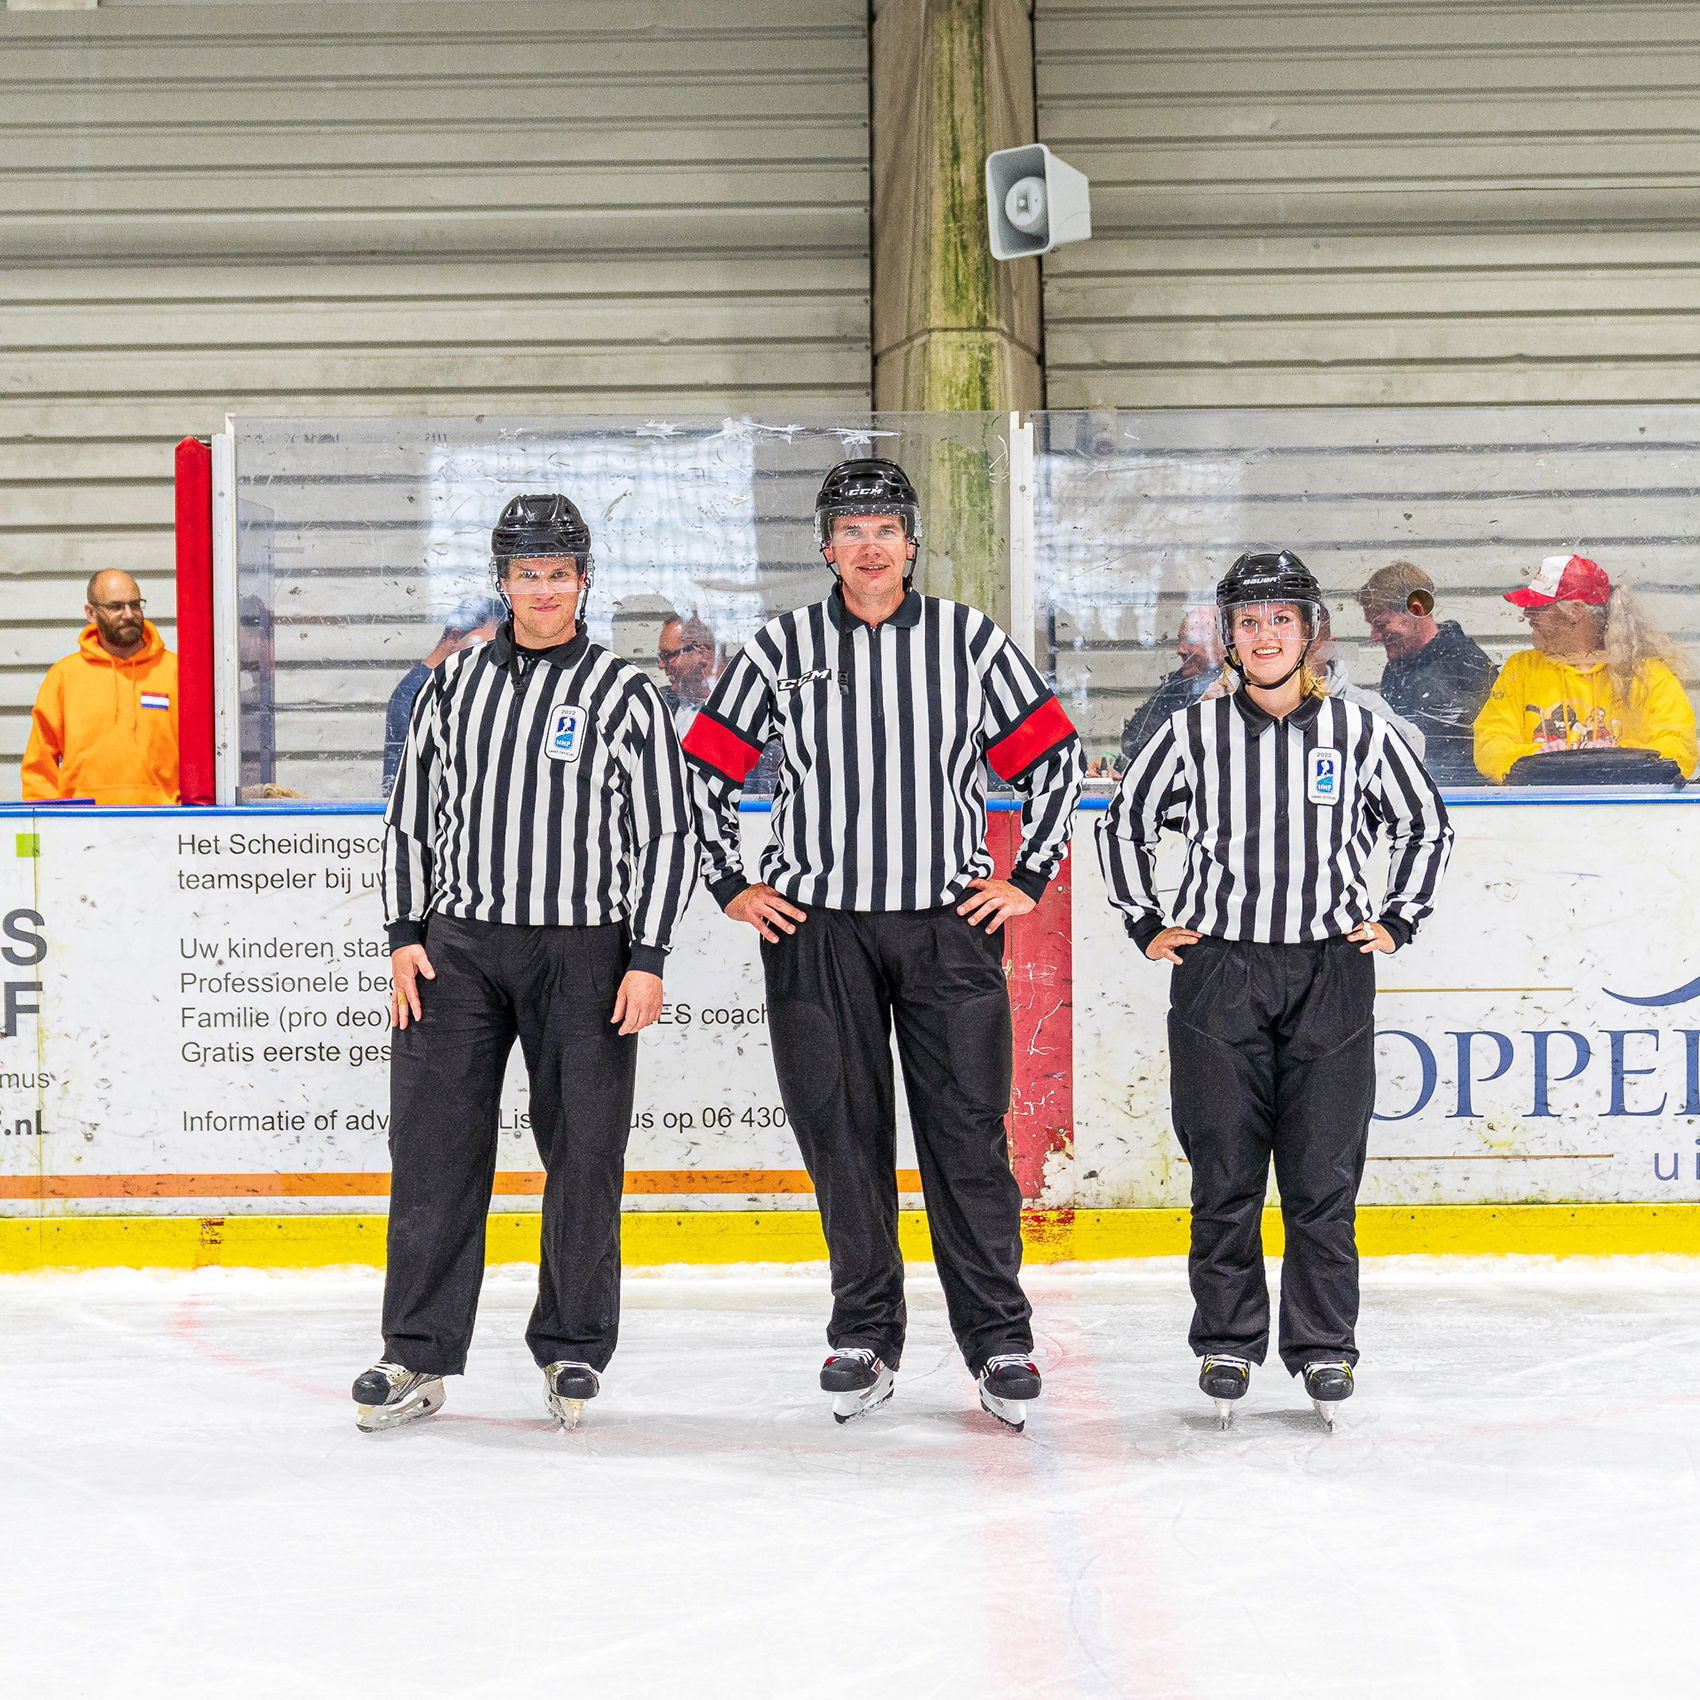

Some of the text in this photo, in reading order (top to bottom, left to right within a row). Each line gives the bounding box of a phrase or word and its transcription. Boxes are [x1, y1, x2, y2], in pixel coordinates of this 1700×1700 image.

[849, 488, 882, 496] CCM
[778, 669, 831, 690] CCM
[178, 833, 385, 859] Het Scheidingsc
[178, 868, 317, 894] teamspeler
[325, 867, 351, 894] bij
[2, 908, 48, 966] S
[180, 938, 219, 959] Uw
[228, 937, 334, 958] kinderen
[181, 971, 348, 993] Professionele
[3, 981, 43, 1037] F
[181, 1006, 269, 1028] Familie
[279, 1006, 327, 1033] (pro
[336, 1005, 391, 1032] deo)
[181, 1041, 392, 1067] Gratis eerste ges
[183, 1110, 305, 1132] Informatie
[314, 1109, 338, 1131] of
[345, 1109, 389, 1131] adv
[663, 1112, 693, 1133] op
[702, 1107, 733, 1128] 06
[741, 1107, 786, 1128] 430
